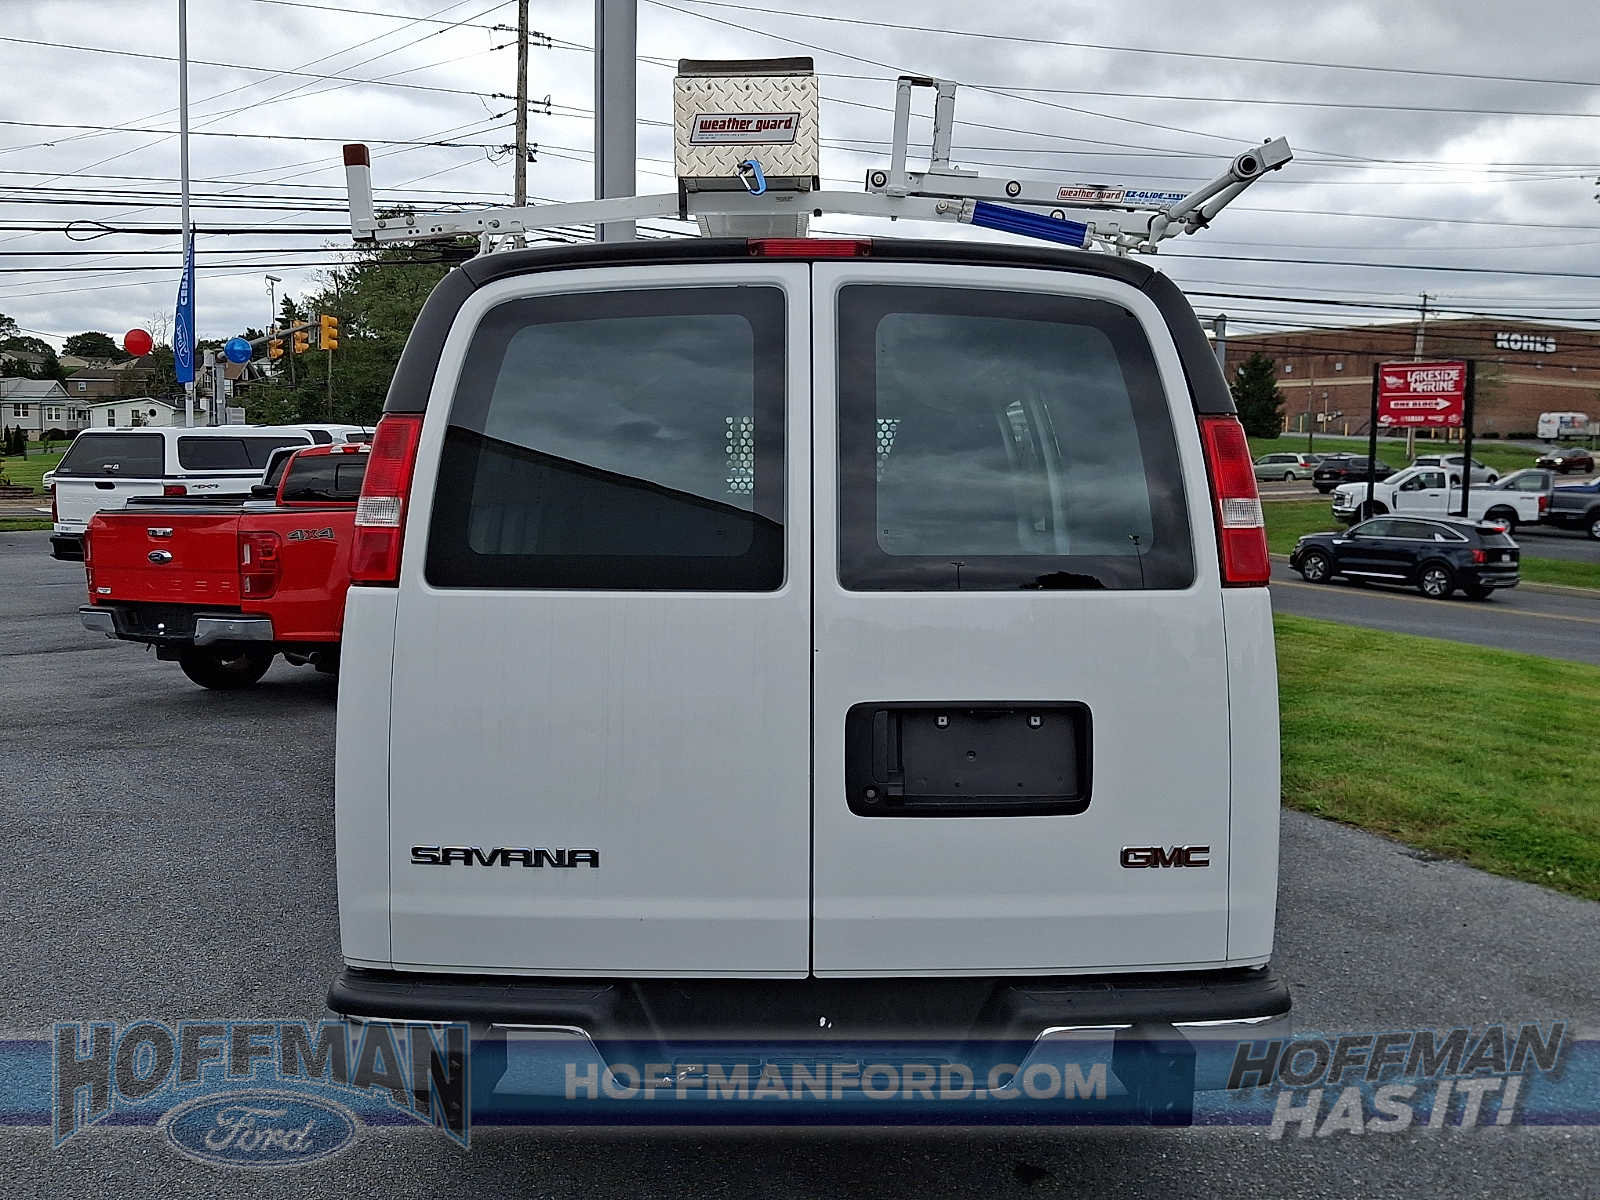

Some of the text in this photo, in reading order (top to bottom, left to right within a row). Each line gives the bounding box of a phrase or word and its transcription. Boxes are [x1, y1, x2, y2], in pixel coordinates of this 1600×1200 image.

[699, 116, 794, 132] weather guard
[1059, 189, 1096, 199] weather
[1407, 370, 1460, 382] LAKESIDE
[1410, 380, 1456, 392] MARINE
[411, 846, 600, 868] SAVANA
[1120, 846, 1210, 868] GMC
